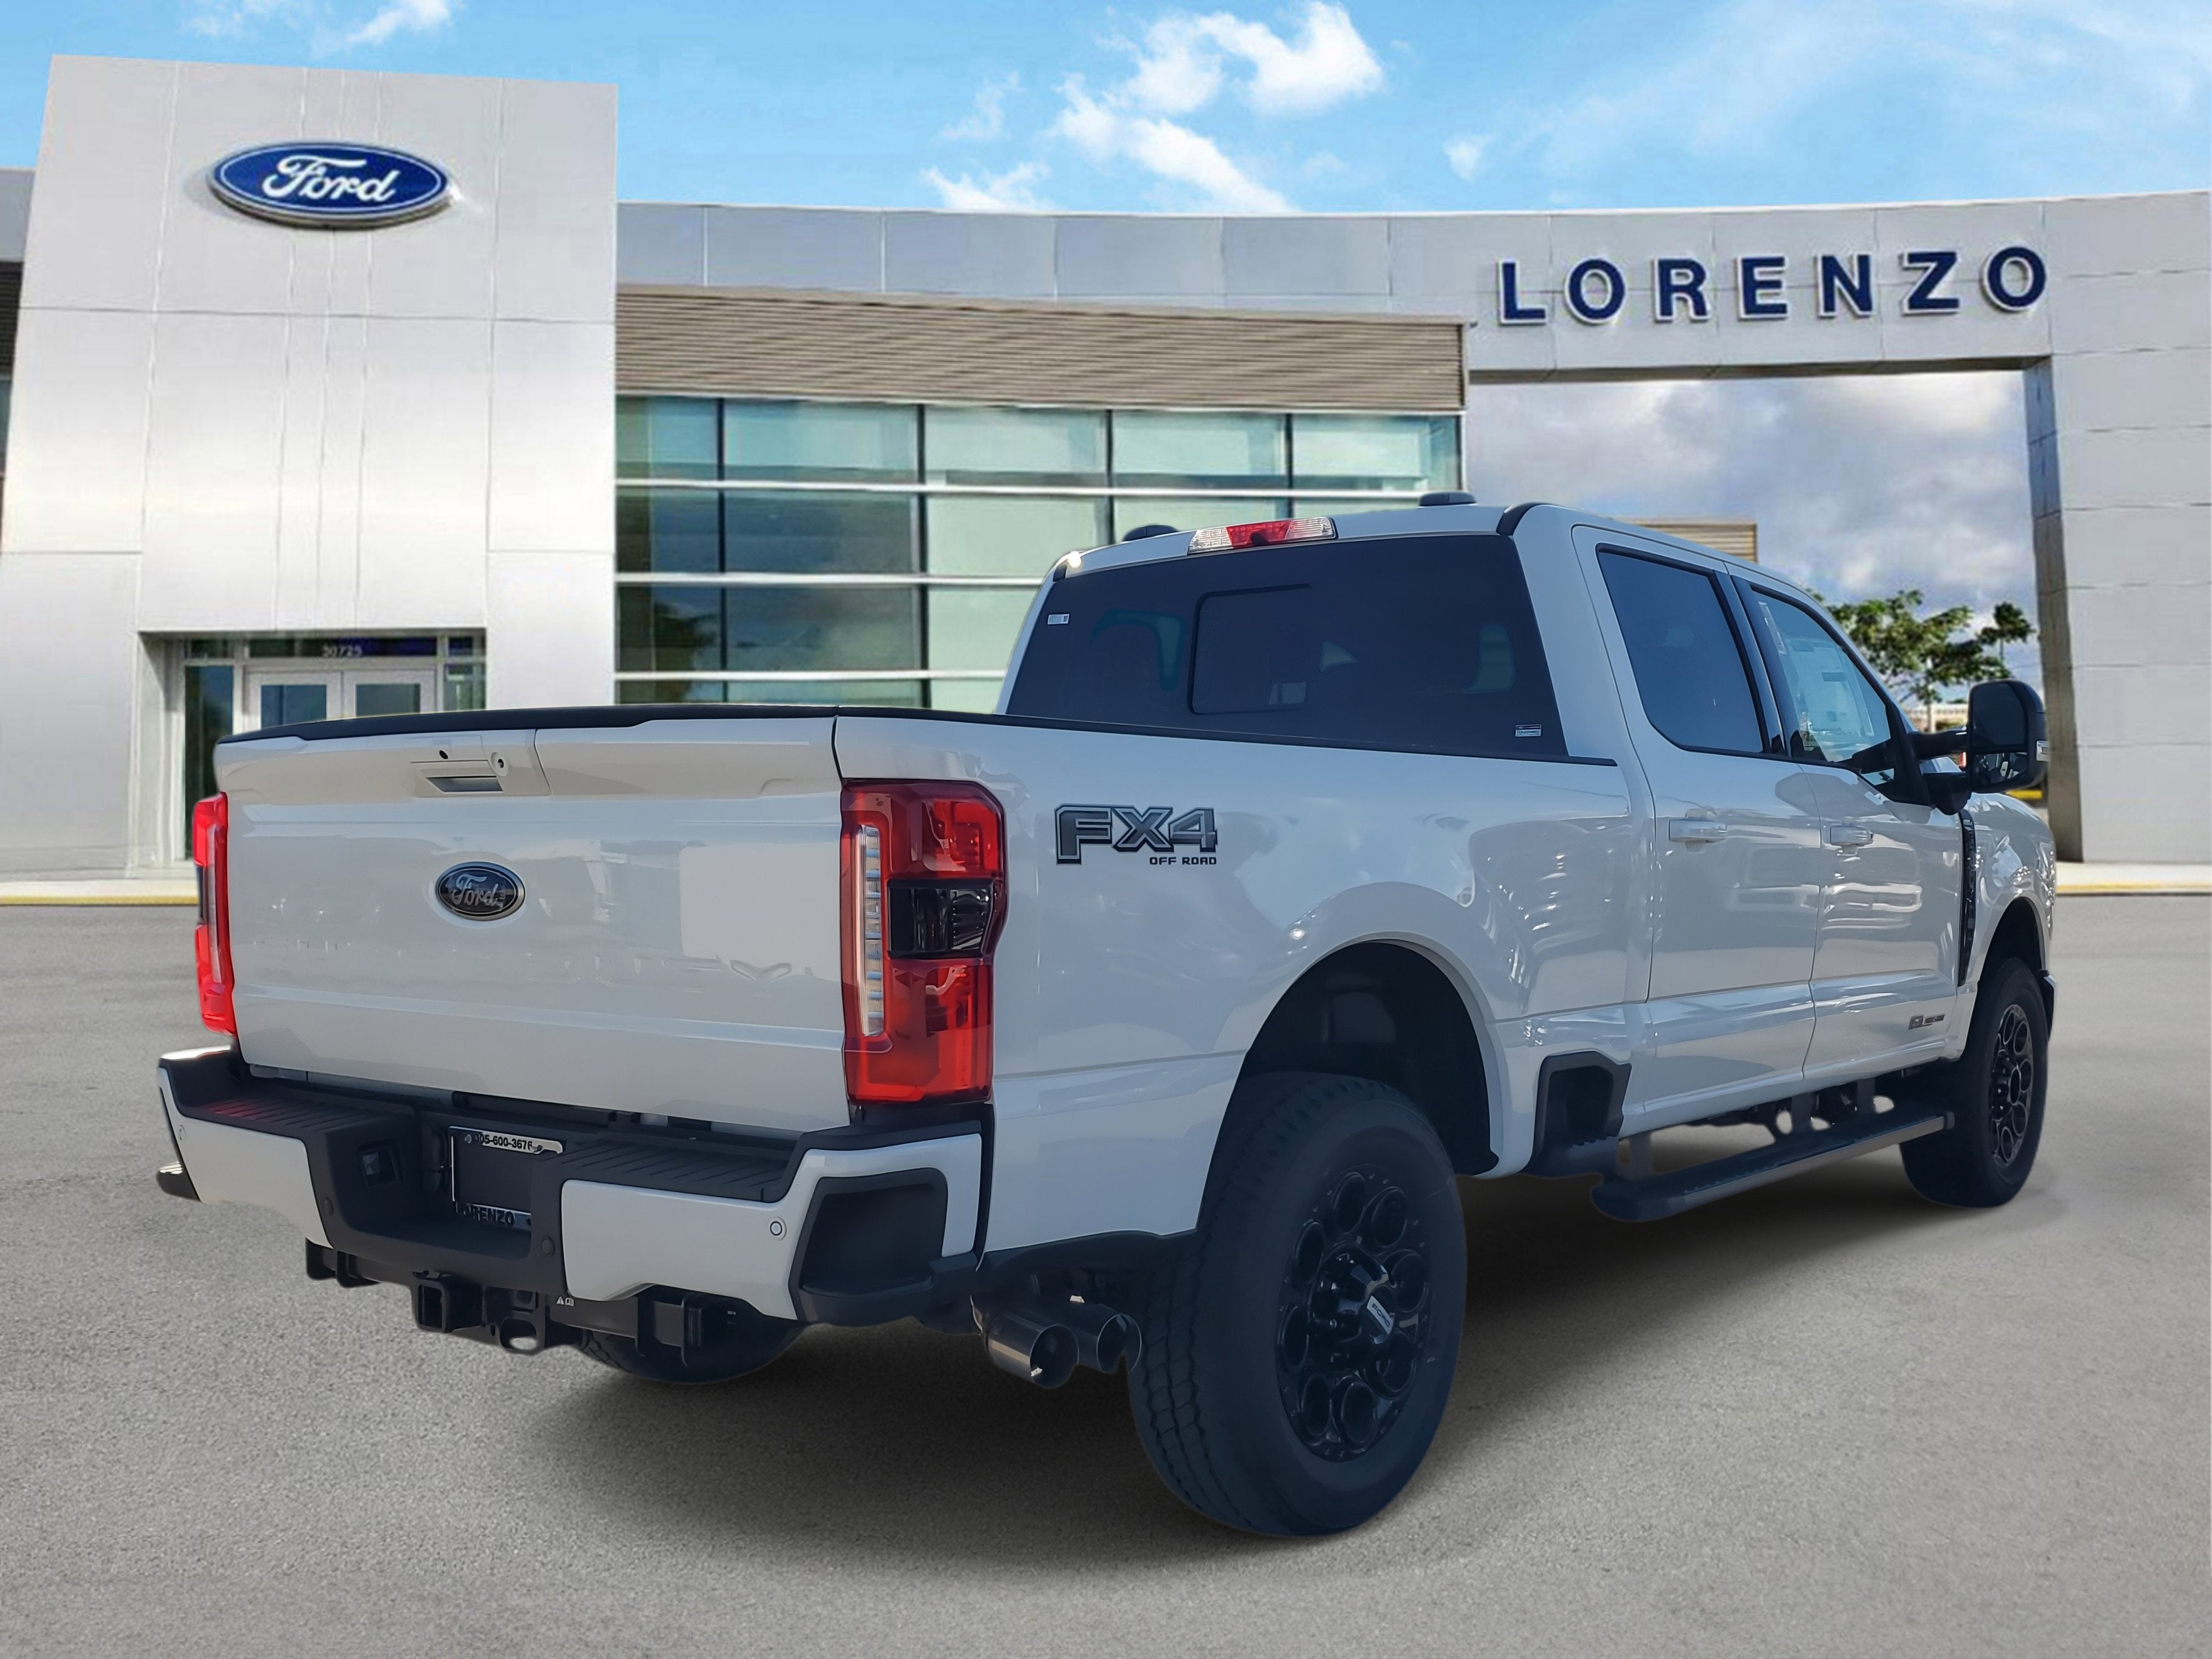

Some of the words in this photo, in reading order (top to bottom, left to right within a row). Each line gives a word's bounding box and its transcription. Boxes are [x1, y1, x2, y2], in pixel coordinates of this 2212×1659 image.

[262, 155, 400, 201] Ford
[1499, 246, 2047, 324] LORENZO
[1054, 803, 1217, 864] FX4
[1149, 857, 1176, 865] OFF
[1182, 857, 1217, 865] ROAD
[452, 874, 499, 907] Ford
